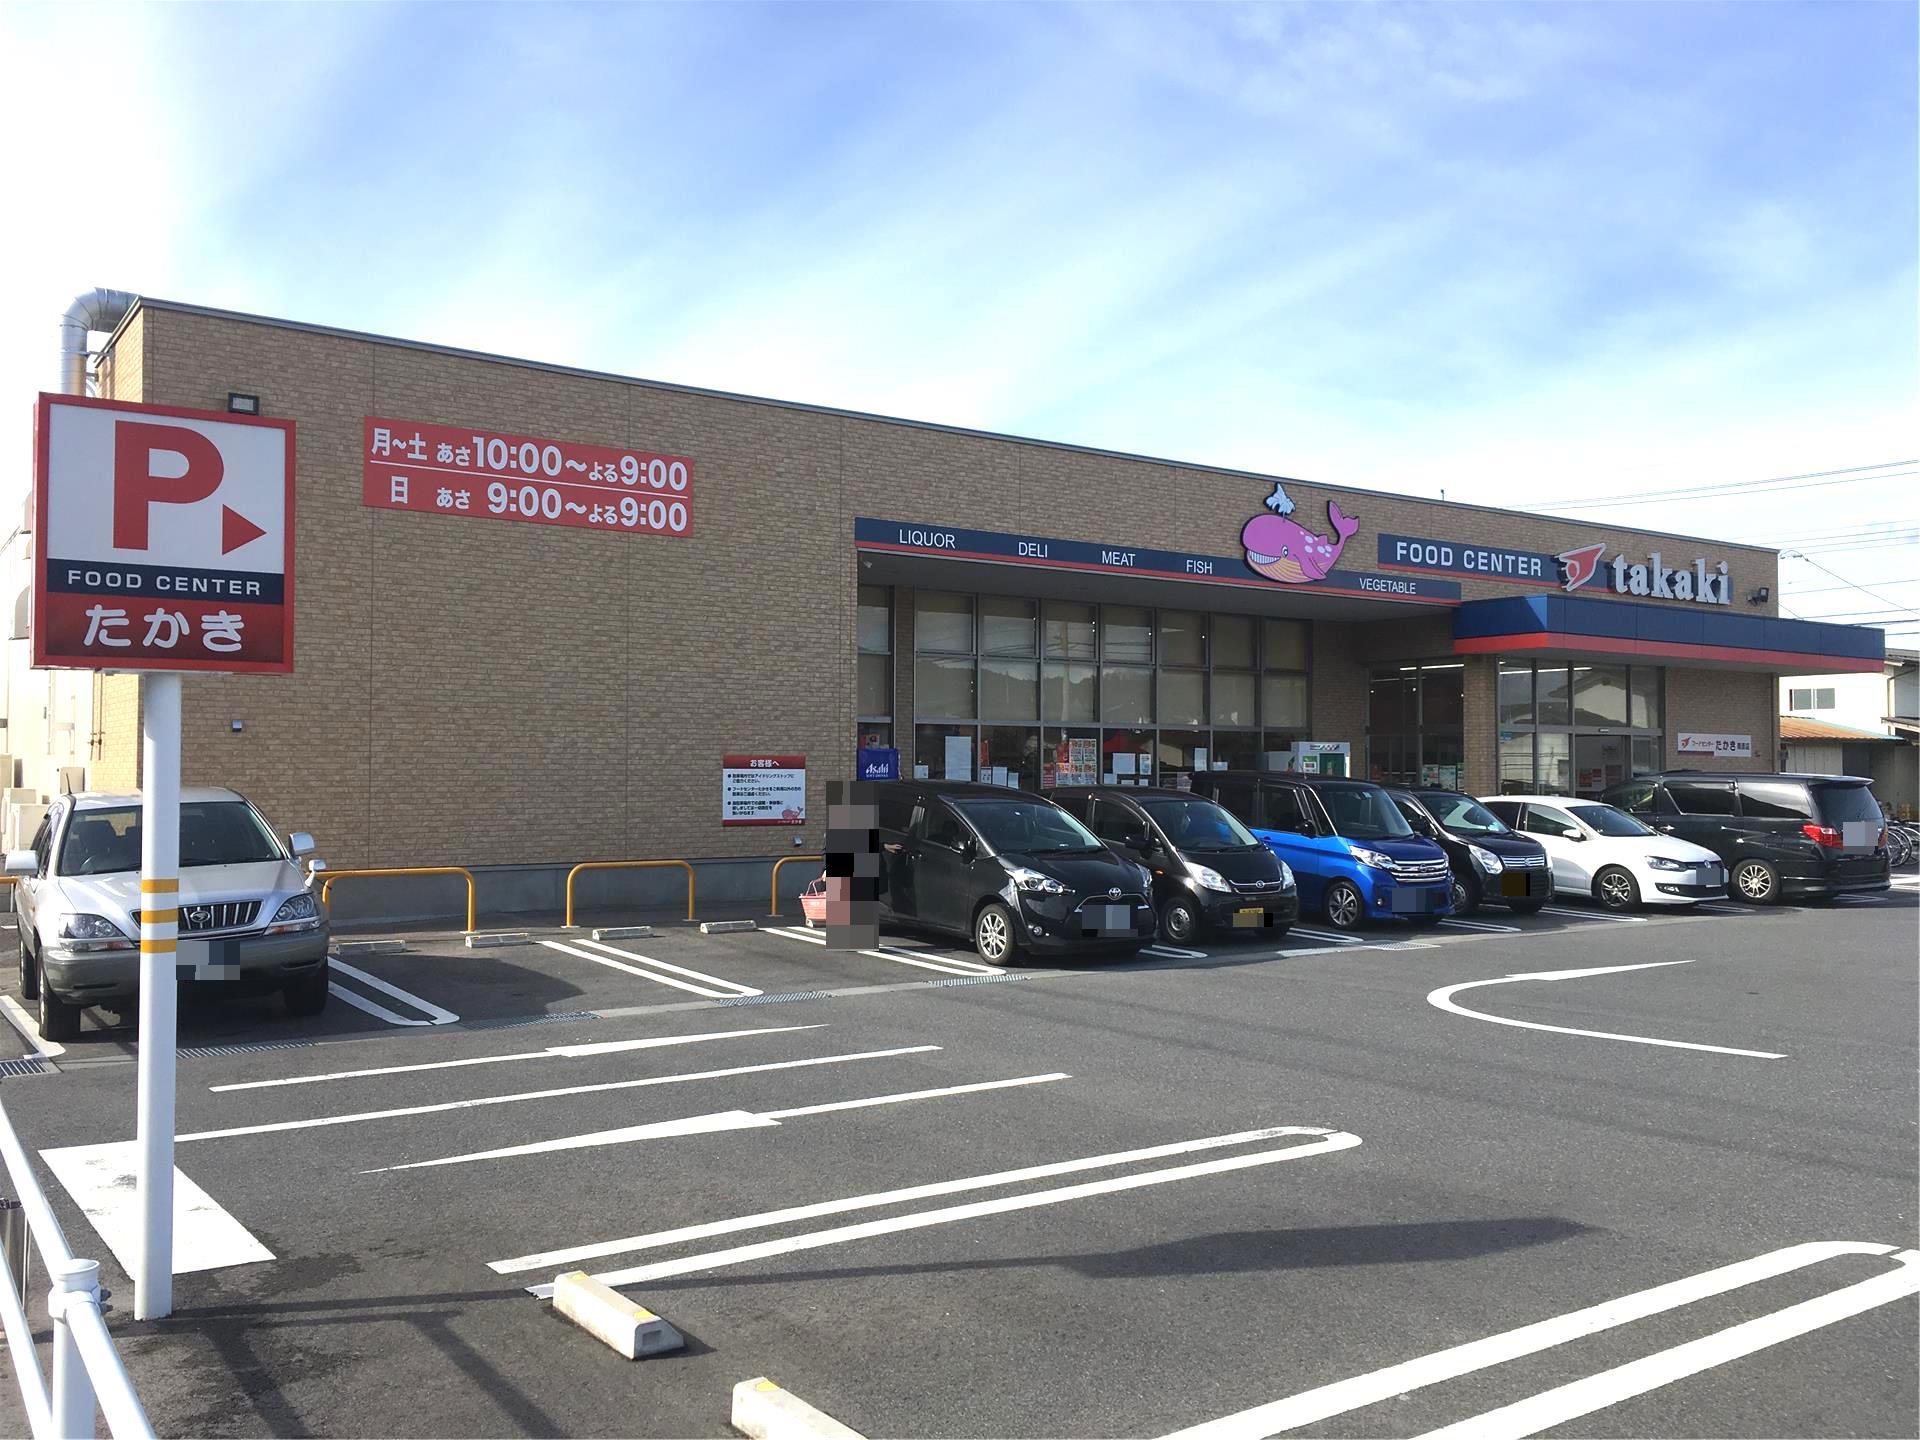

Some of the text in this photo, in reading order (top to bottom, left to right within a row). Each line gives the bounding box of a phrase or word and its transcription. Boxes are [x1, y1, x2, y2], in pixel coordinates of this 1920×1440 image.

[112, 419, 225, 551] P
[391, 475, 409, 504] 日
[899, 529, 956, 549] LIQUOR
[1018, 542, 1049, 558] DELI
[1101, 550, 1136, 567] MEAT
[1396, 541, 1542, 577] FOOD CENTER
[1186, 559, 1213, 575] FISH
[67, 569, 261, 596] FOOD CENTER
[1359, 577, 1417, 595] VEGETABLE
[1612, 552, 1731, 605] takaki
[83, 604, 244, 652] たかき
[1715, 739, 1737, 752] たかき
[750, 759, 780, 768] お客様へ
[865, 763, 889, 774] Asahi
